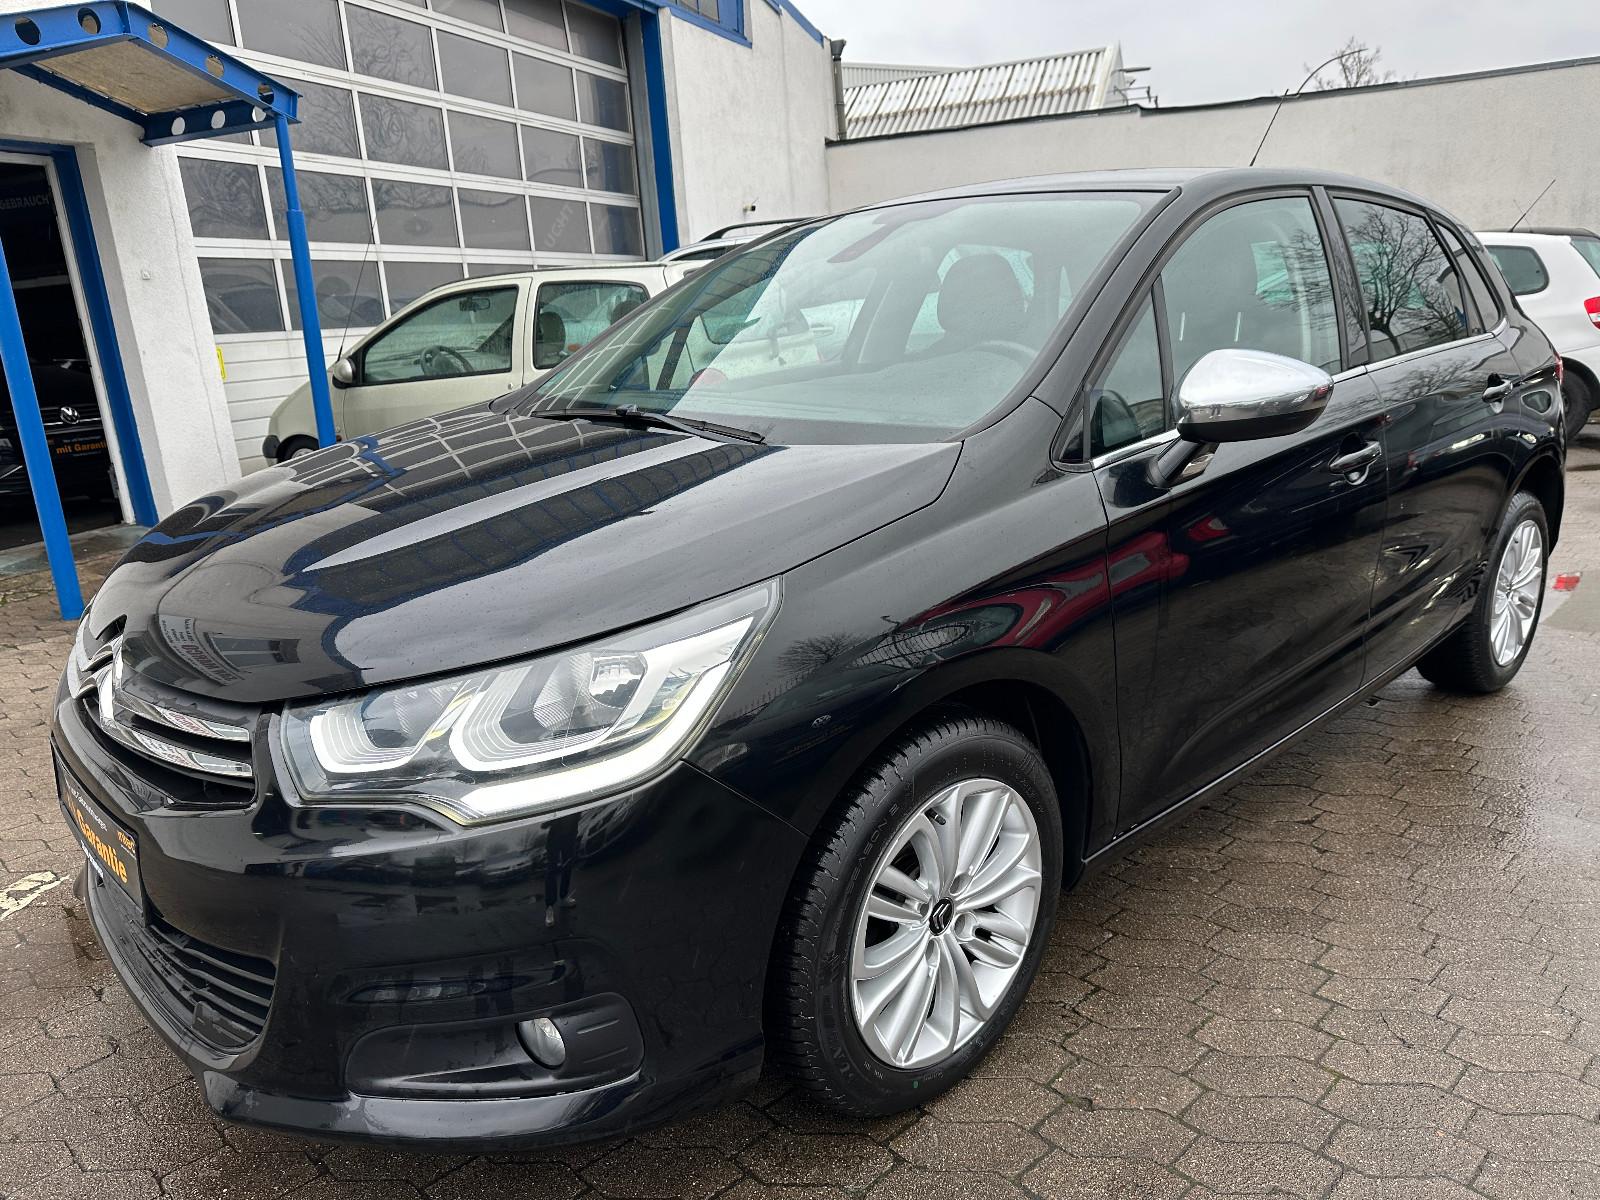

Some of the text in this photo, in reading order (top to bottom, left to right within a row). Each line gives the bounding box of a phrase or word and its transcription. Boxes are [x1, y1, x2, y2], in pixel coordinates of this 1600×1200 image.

[56, 444, 73, 455] mit
[74, 440, 107, 452] Garanti
[77, 808, 128, 883] Garantie
